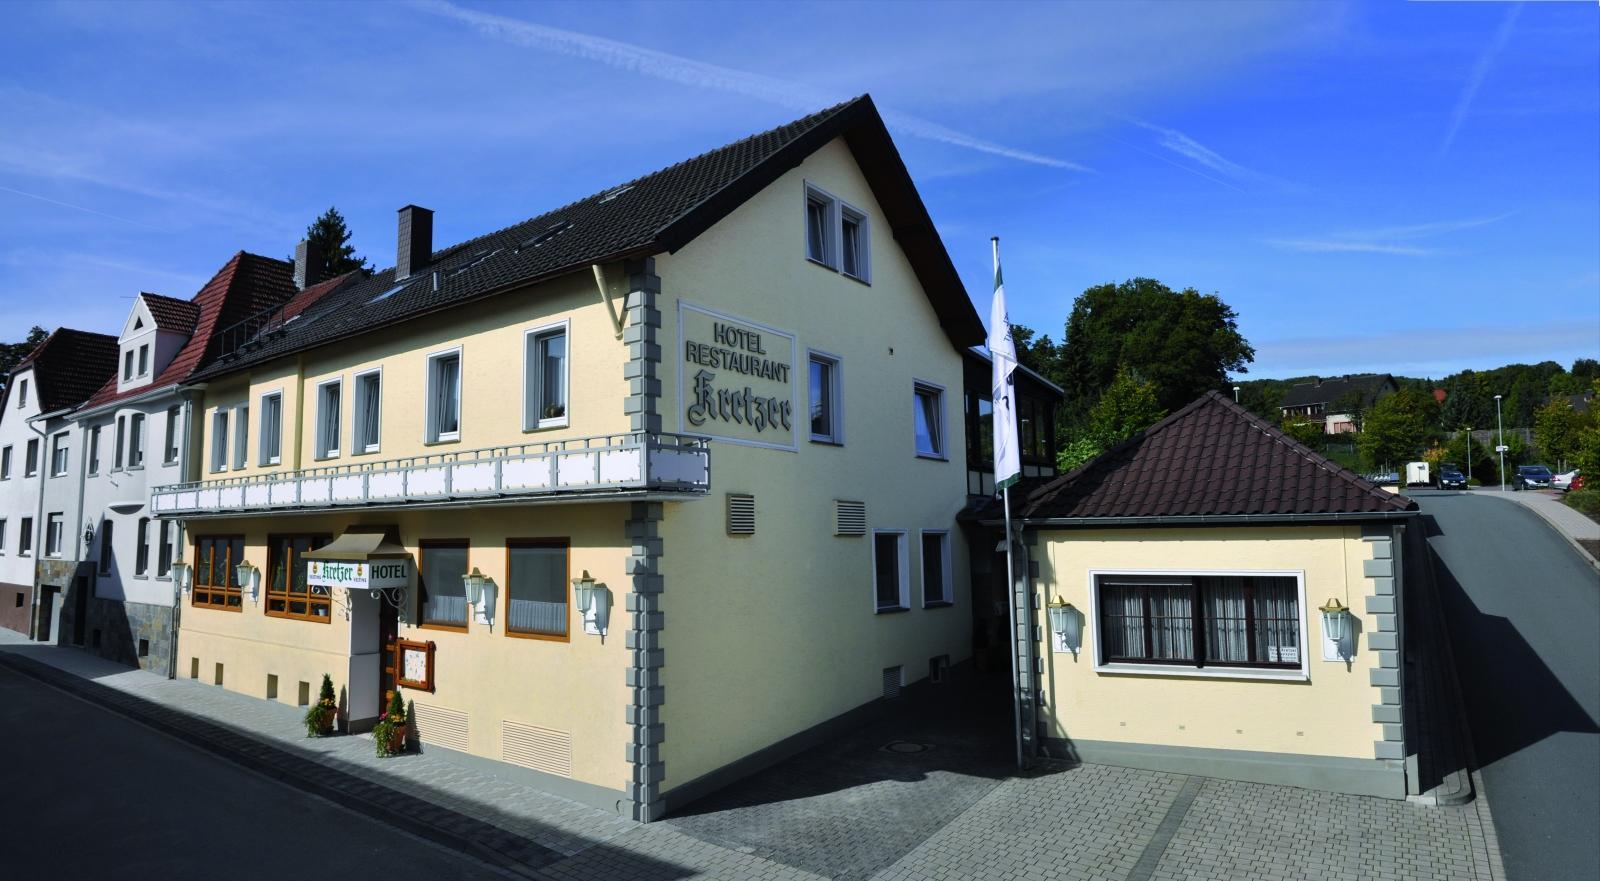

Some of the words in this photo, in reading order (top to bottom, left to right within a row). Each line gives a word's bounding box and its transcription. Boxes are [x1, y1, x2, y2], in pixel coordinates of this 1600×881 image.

[713, 322, 767, 355] HOTEL
[685, 340, 790, 383] RESTAURANT
[687, 369, 792, 432] Kretzer
[322, 560, 353, 582] Kretzer
[371, 564, 407, 579] HOTEL
